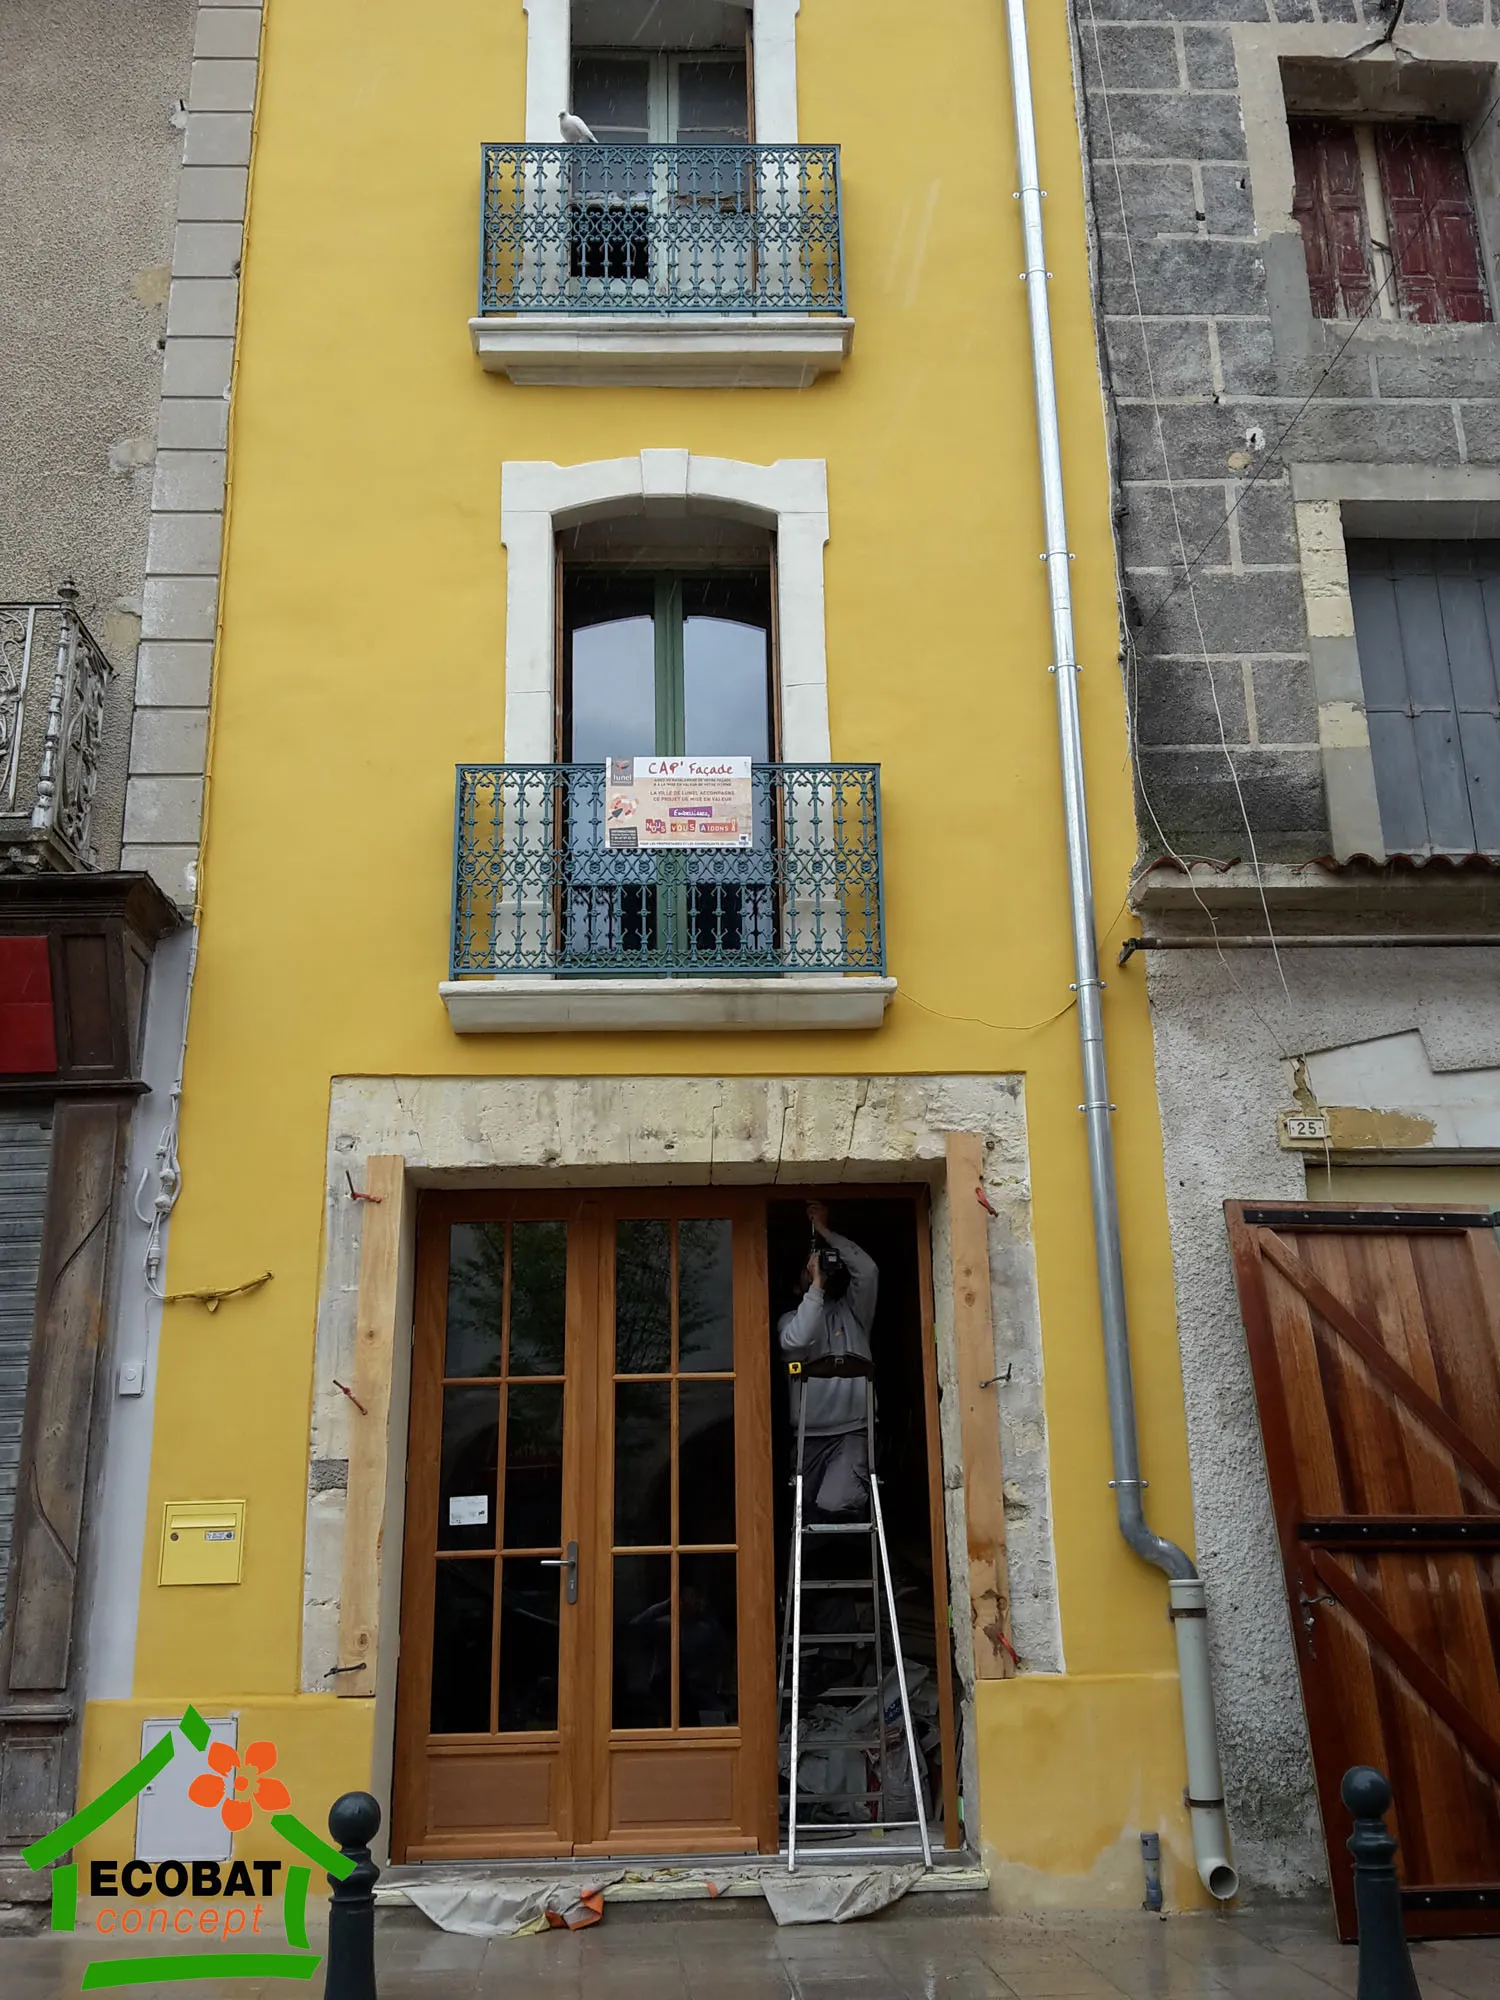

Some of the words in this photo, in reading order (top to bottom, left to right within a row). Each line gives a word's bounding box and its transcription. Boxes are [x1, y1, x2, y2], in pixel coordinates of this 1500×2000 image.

[648, 761, 683, 775] CAP'
[689, 762, 734, 776] Façade
[646, 820, 666, 833] NOUS
[671, 823, 695, 831] VOUS
[1297, 1121, 1317, 1135] 25
